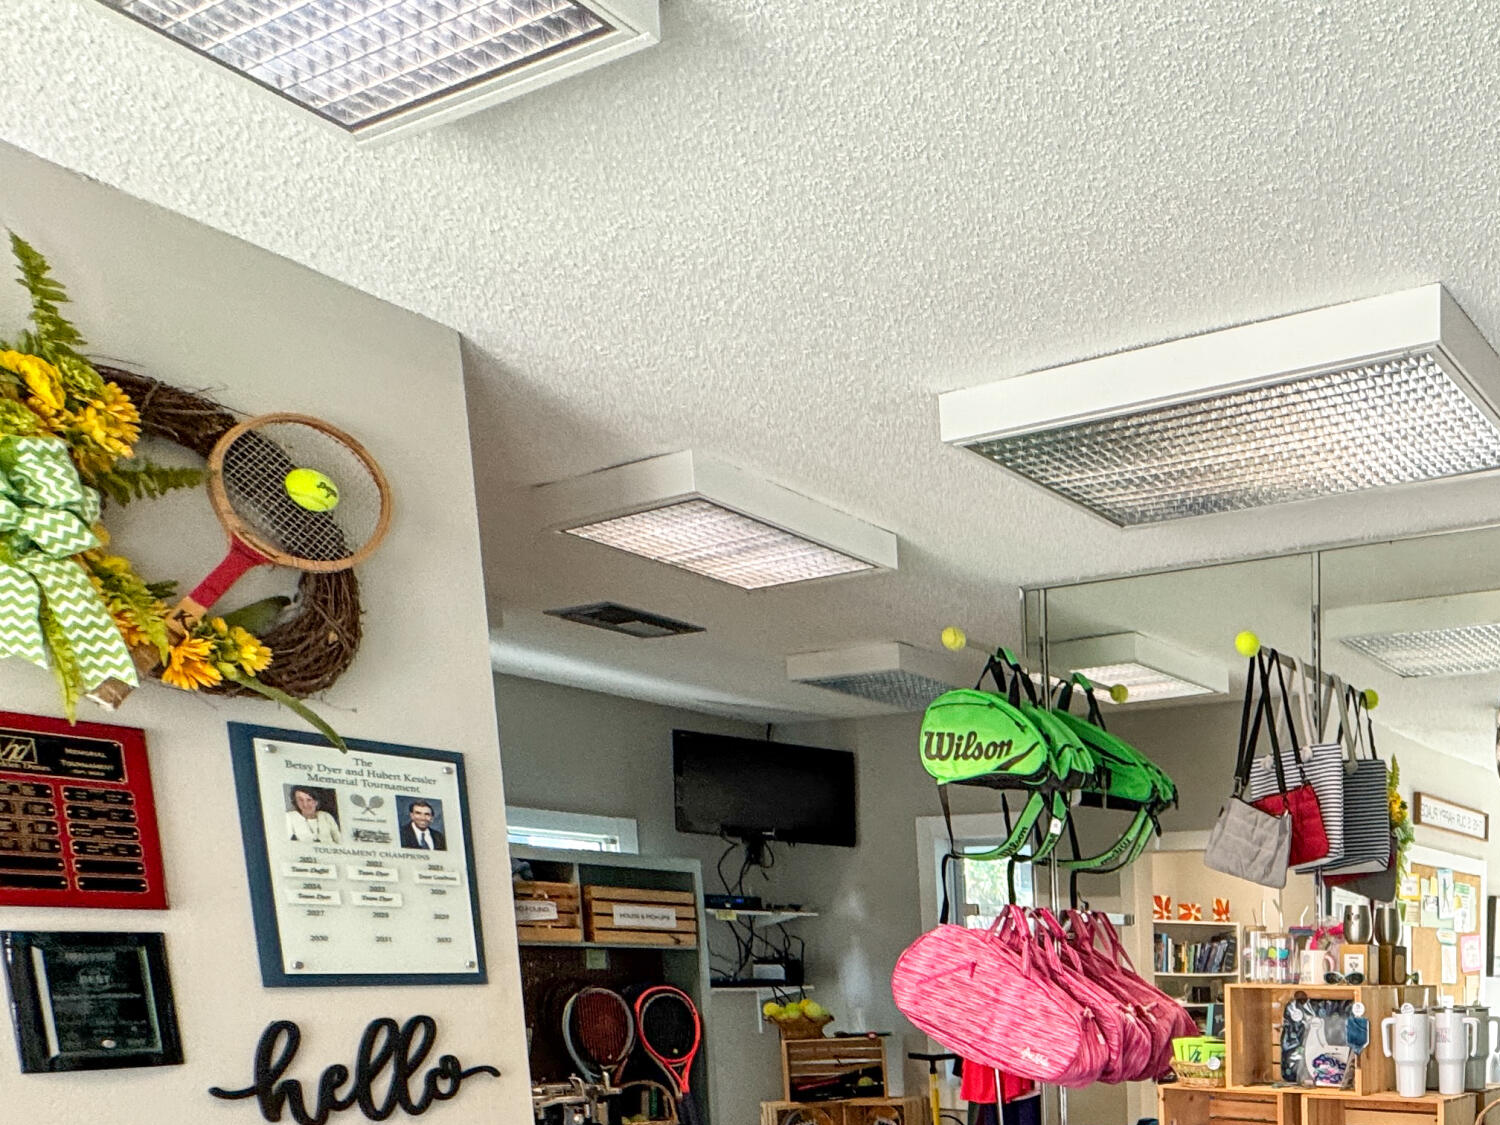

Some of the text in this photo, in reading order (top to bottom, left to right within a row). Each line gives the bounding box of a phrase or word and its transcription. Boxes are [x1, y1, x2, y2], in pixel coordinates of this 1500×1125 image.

[924, 731, 1013, 761] Wilson
[285, 760, 437, 785] Betsy Dyer and Hubert Kessler
[353, 758, 372, 767] The
[307, 773, 421, 793] Memorial Tournament
[313, 846, 430, 861] TOURNAMENT CHAMPIONS
